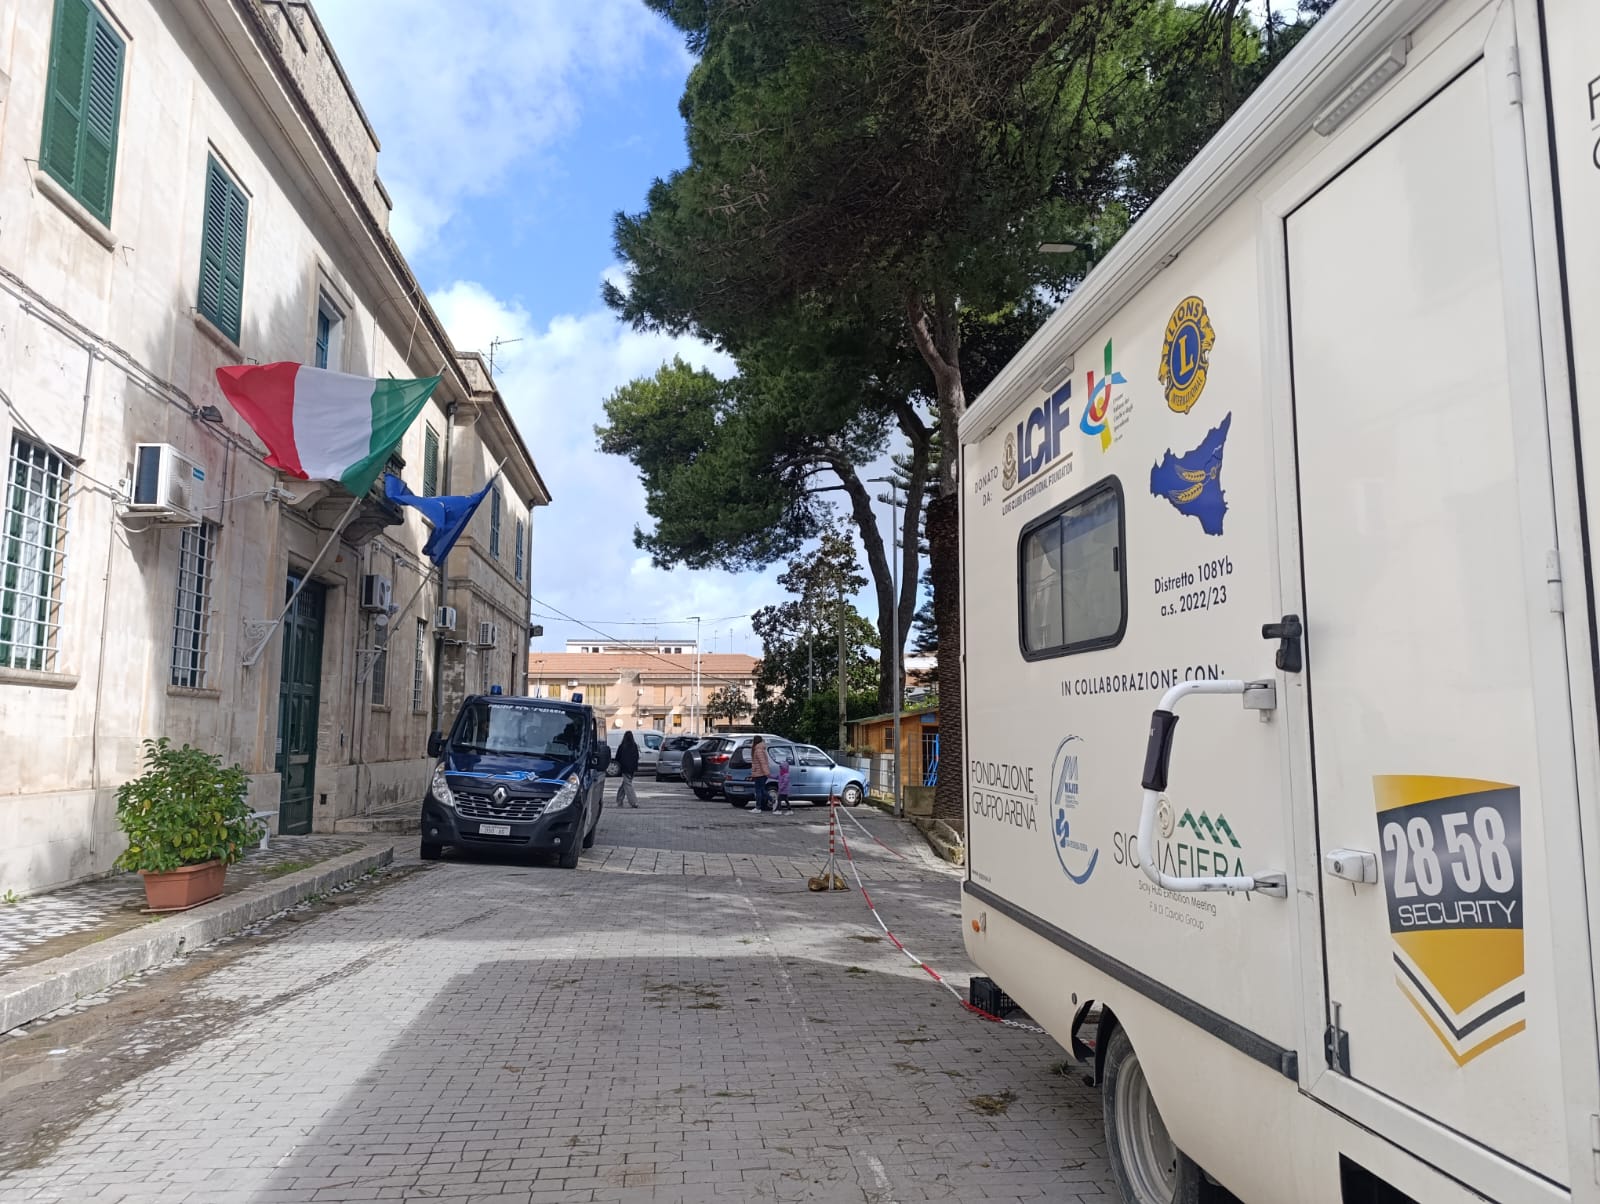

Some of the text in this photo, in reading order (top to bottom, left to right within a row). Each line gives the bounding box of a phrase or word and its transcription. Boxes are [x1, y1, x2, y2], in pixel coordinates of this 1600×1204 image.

[1168, 300, 1201, 335] LIONS
[1179, 335, 1194, 376] L
[1017, 379, 1072, 484] LCIF
[974, 465, 999, 494] DONATO
[982, 491, 993, 506] DA:
[1154, 555, 1234, 594] Distretto 108Yb
[1160, 585, 1228, 617] a.s. 2022/23
[1061, 681, 1072, 697] IN
[1074, 669, 1178, 696] COLLABORAZIONE
[971, 760, 1035, 794] FONDAZIONE
[1191, 896, 1217, 917] Meeting
[1398, 900, 1517, 926] SECURITY
